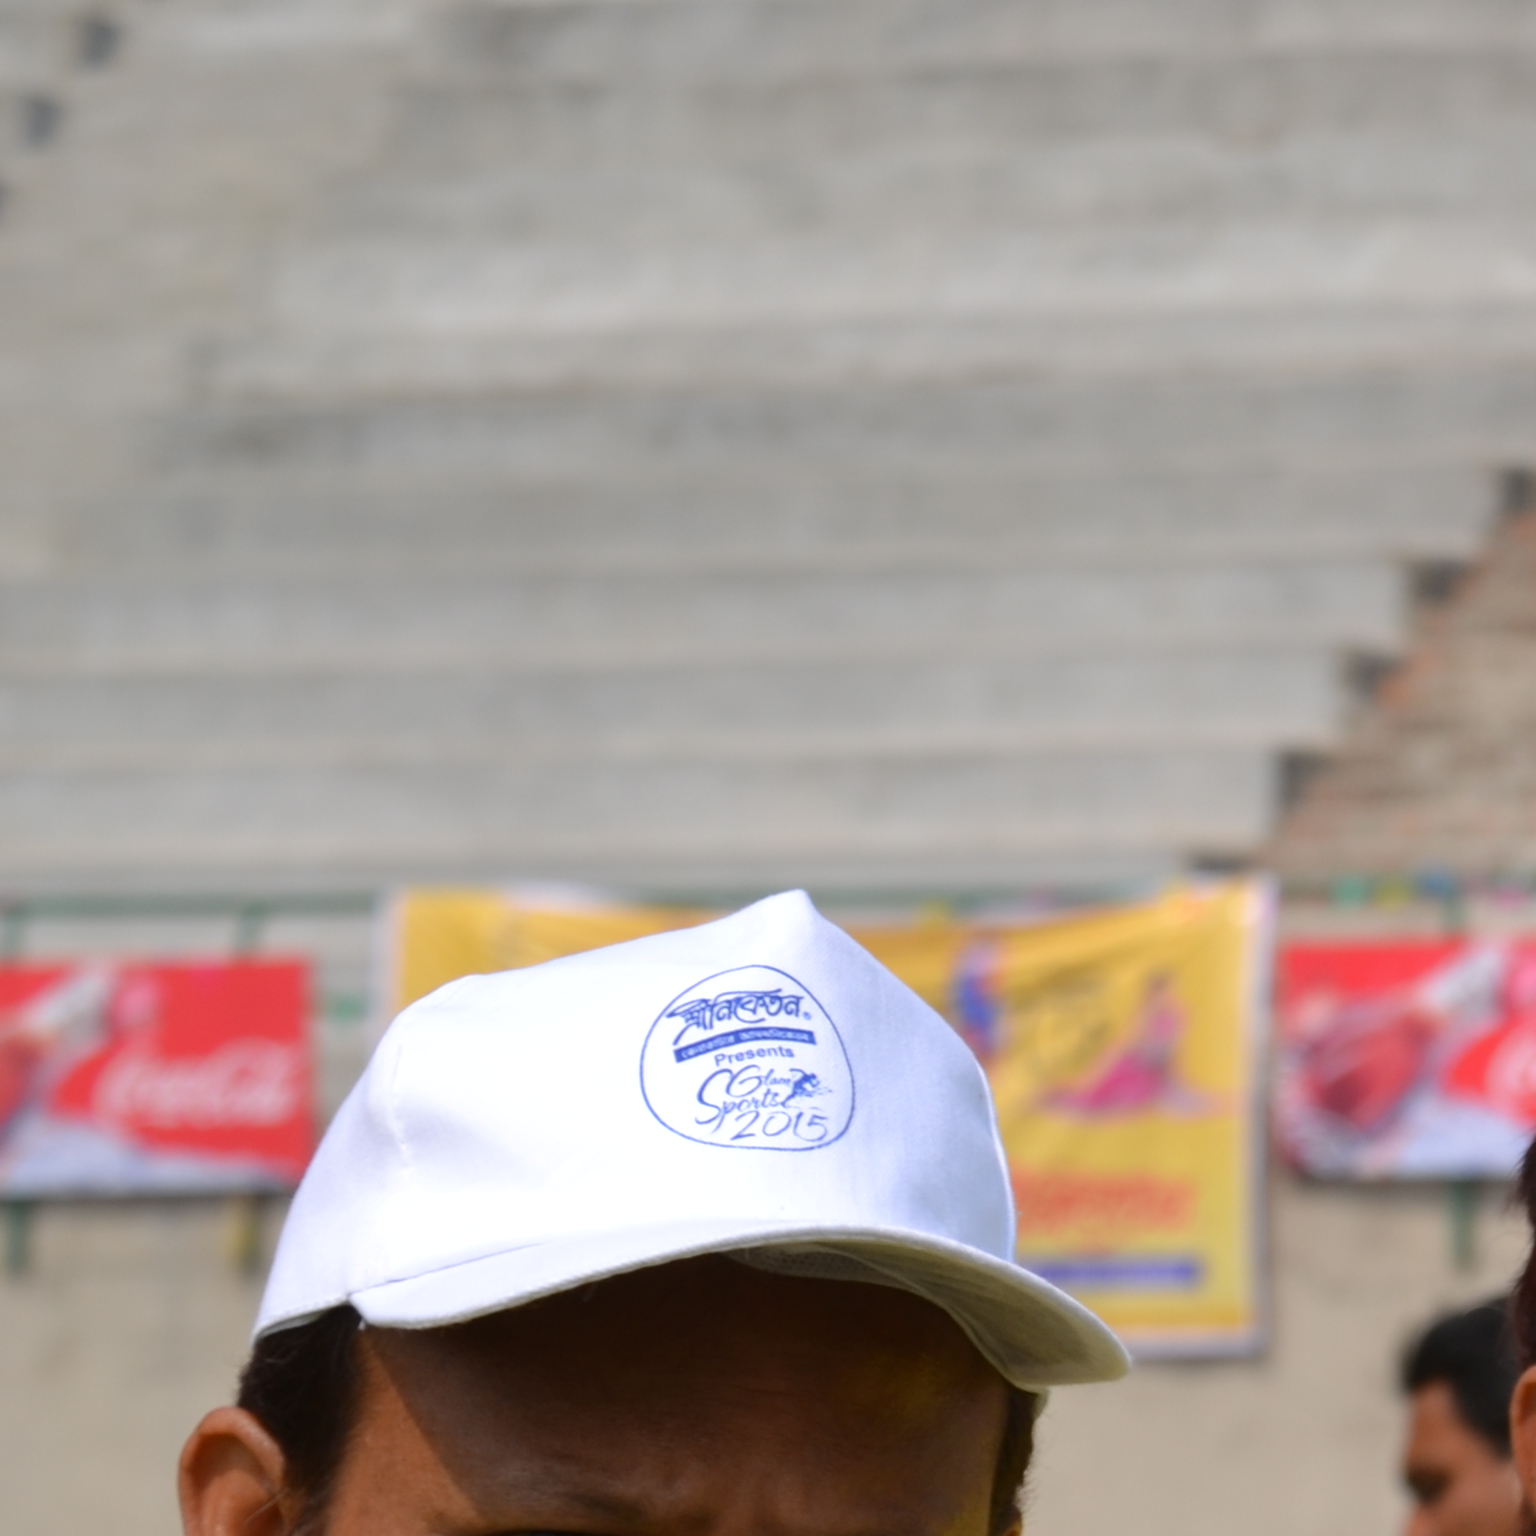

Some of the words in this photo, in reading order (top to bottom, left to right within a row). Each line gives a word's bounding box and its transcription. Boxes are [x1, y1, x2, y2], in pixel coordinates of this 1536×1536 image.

[713, 1046, 796, 1068] Presents
[694, 1068, 780, 1135] Sports
[730, 1110, 828, 1142] 2015
